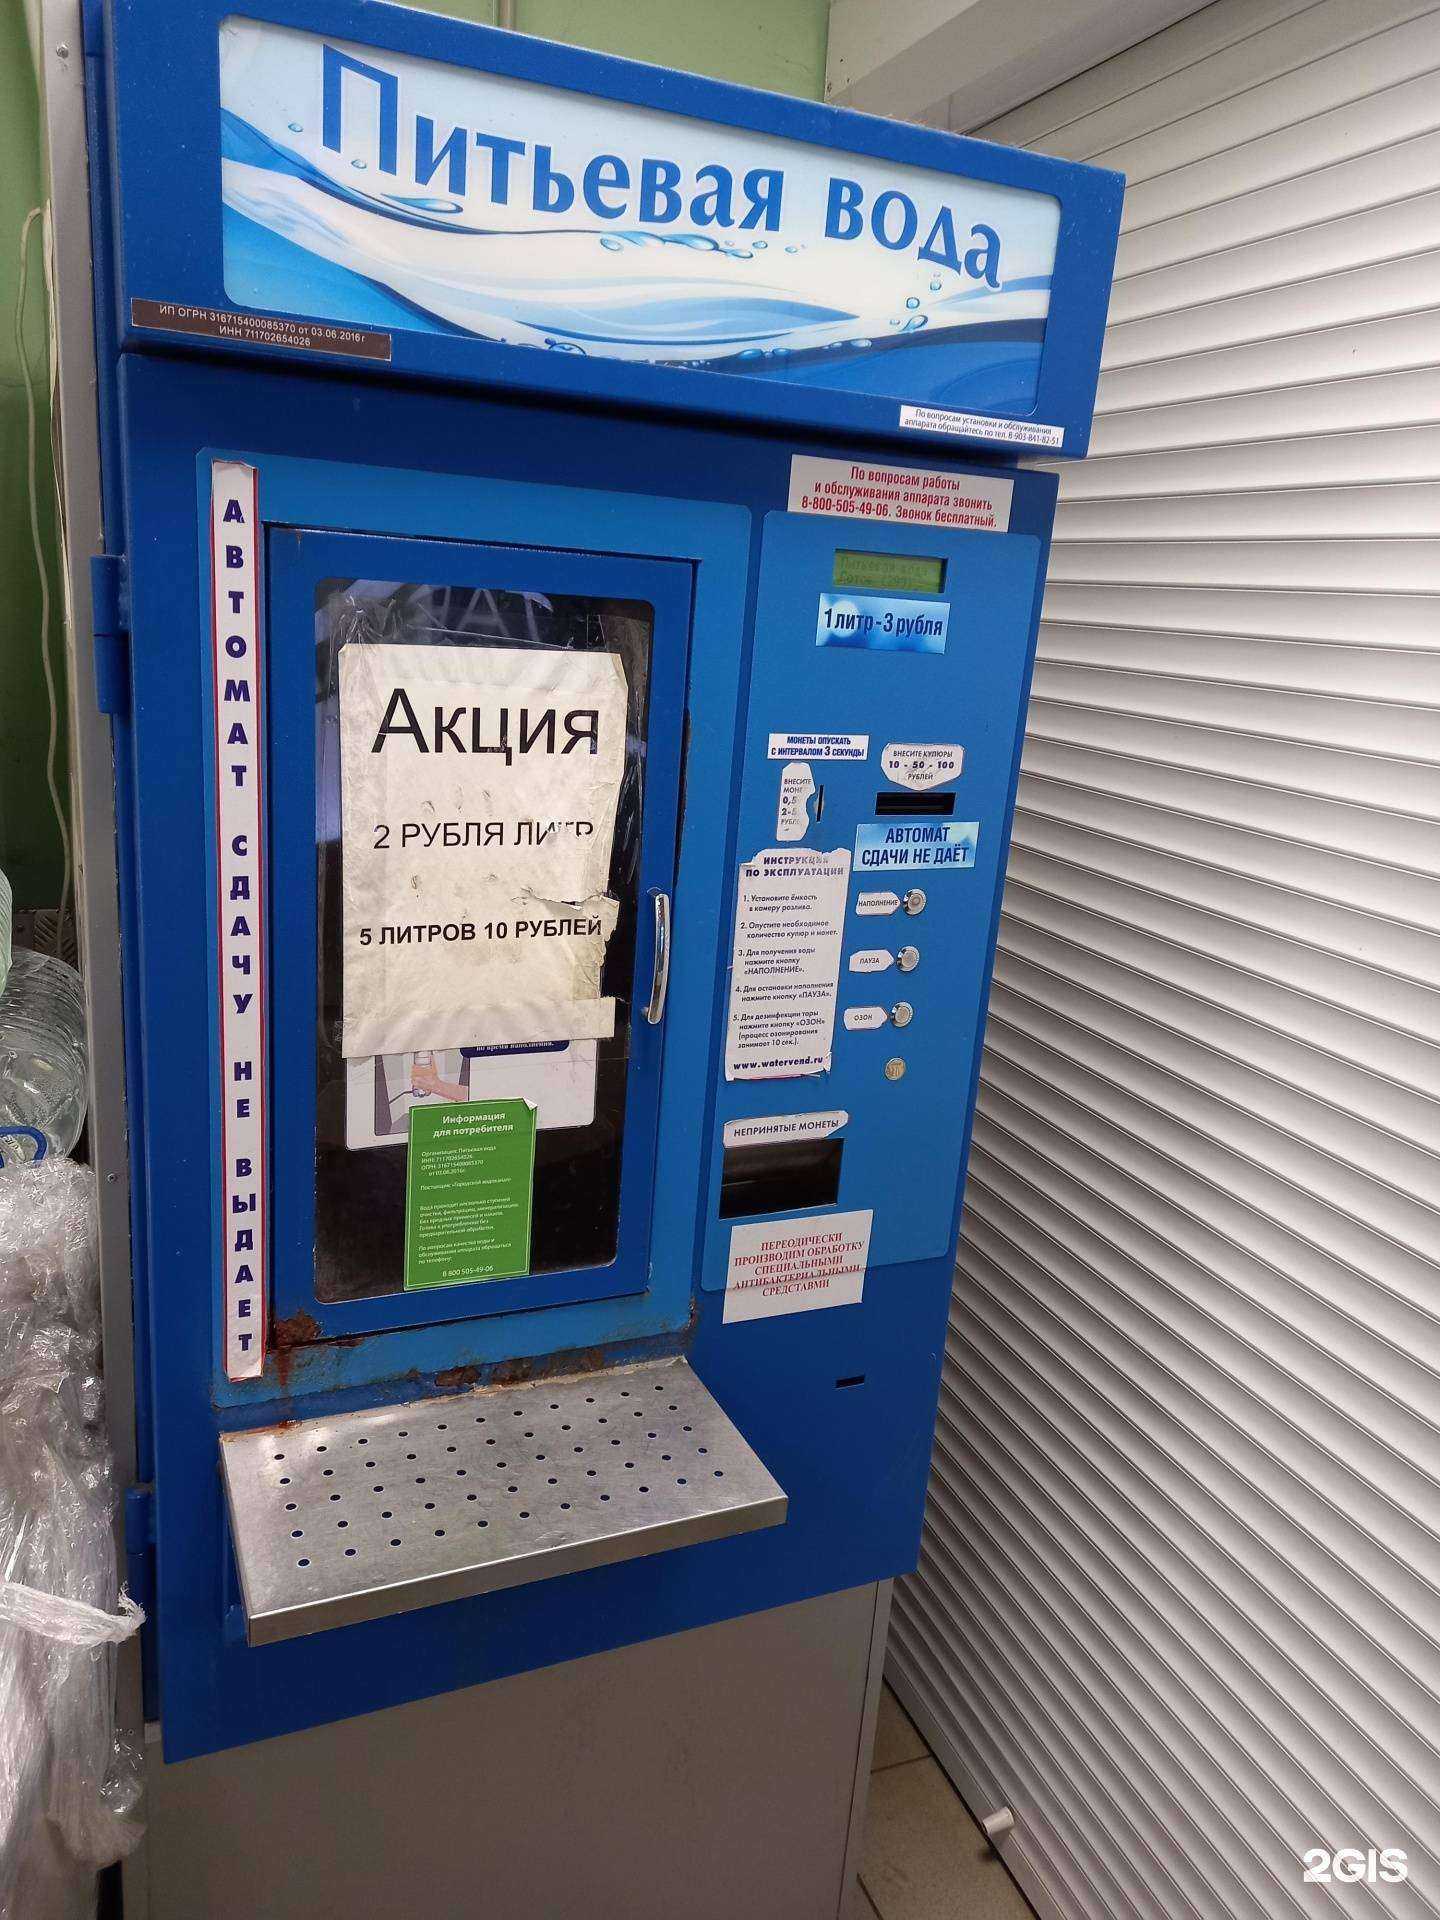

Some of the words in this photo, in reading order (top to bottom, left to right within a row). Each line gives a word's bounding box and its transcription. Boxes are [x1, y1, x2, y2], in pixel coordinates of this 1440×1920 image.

[322, 43, 784, 232] Питьевая
[824, 177, 1002, 288] вода
[160, 305, 175, 315] ИП
[178, 308, 206, 320] ОГРН
[220, 326, 241, 336] ИНН
[245, 328, 311, 347] 711702654026
[905, 419, 936, 429] аппарата
[938, 422, 983, 435] обращайтесь
[916, 409, 925, 417] По
[927, 412, 961, 422] вопросам
[962, 417, 997, 430] установки
[851, 466, 865, 480] По
[868, 470, 920, 487] вопросам
[923, 475, 960, 491] работы
[814, 482, 821, 492] и
[824, 482, 900, 501] обслуживания
[903, 490, 950, 507] аппарата
[953, 498, 992, 511] звонить
[801, 497, 892, 518] 8-800-505-49-06.
[896, 505, 932, 520] Звонок
[935, 512, 997, 528] бесплатный.
[824, 608, 833, 628] 1
[896, 614, 943, 637] рубля
[223, 499, 250, 787] АВТОМАТ
[371, 688, 599, 766] Акция
[787, 736, 817, 744] МОНЕТЫ
[818, 736, 851, 745] ОПУСКАТЬ
[778, 748, 823, 756] ИНТЕРВАЛОМ
[825, 746, 830, 756] 3
[833, 748, 865, 757] СЕКУНДЫ
[373, 824, 390, 849] 2
[401, 821, 504, 848] РУБЛЯ
[886, 826, 951, 843] АВТОМАТ
[862, 850, 910, 866] СДАЧИ
[912, 848, 930, 864] НЕ
[933, 844, 969, 864] ДАЁТ
[746, 869, 760, 877] ПО
[764, 867, 844, 876] ЭКСПЛУАТАЦИИ
[230, 834, 253, 1015] СДАЧУ
[359, 928, 372, 946] 5
[379, 923, 476, 945] ЛИТРОВ
[484, 923, 508, 940] 10
[515, 916, 602, 939] РУБЛЕЙ
[749, 922, 780, 930] Опустите
[782, 920, 829, 928] необходимое
[746, 949, 760, 957] Для
[760, 948, 796, 957] получения
[743, 985, 756, 993] Для
[758, 984, 792, 992] остановки
[794, 982, 834, 990] наполнения
[755, 1012, 800, 1021] дезинфекции
[738, 1032, 768, 1040] (процесс
[770, 1030, 818, 1038] озонирования
[734, 1056, 823, 1070] www.watervend.ru
[234, 1061, 252, 1119] НЕ
[442, 1113, 506, 1124] Информация
[734, 1122, 797, 1137] НЕПРИНЯТЫЕ
[798, 1119, 839, 1131] МОНЕТЫ
[433, 1129, 451, 1139] для
[453, 1124, 513, 1136] потребителя
[761, 1232, 843, 1251] ПЕРЕОДИЧЕСКИ
[232, 1158, 256, 1352] ВЫДАЕТ
[734, 1249, 806, 1266] ПРОИЗВОДИМ
[807, 1241, 865, 1256] ОБРАБОТКУ
[755, 1255, 843, 1275] СПЕЦИАЛЬНЫМИ
[734, 1264, 860, 1290] АНТИБАКТЕРИАЛЬНЫМИ
[762, 1279, 830, 1296] СРЕДСТАВМИ
